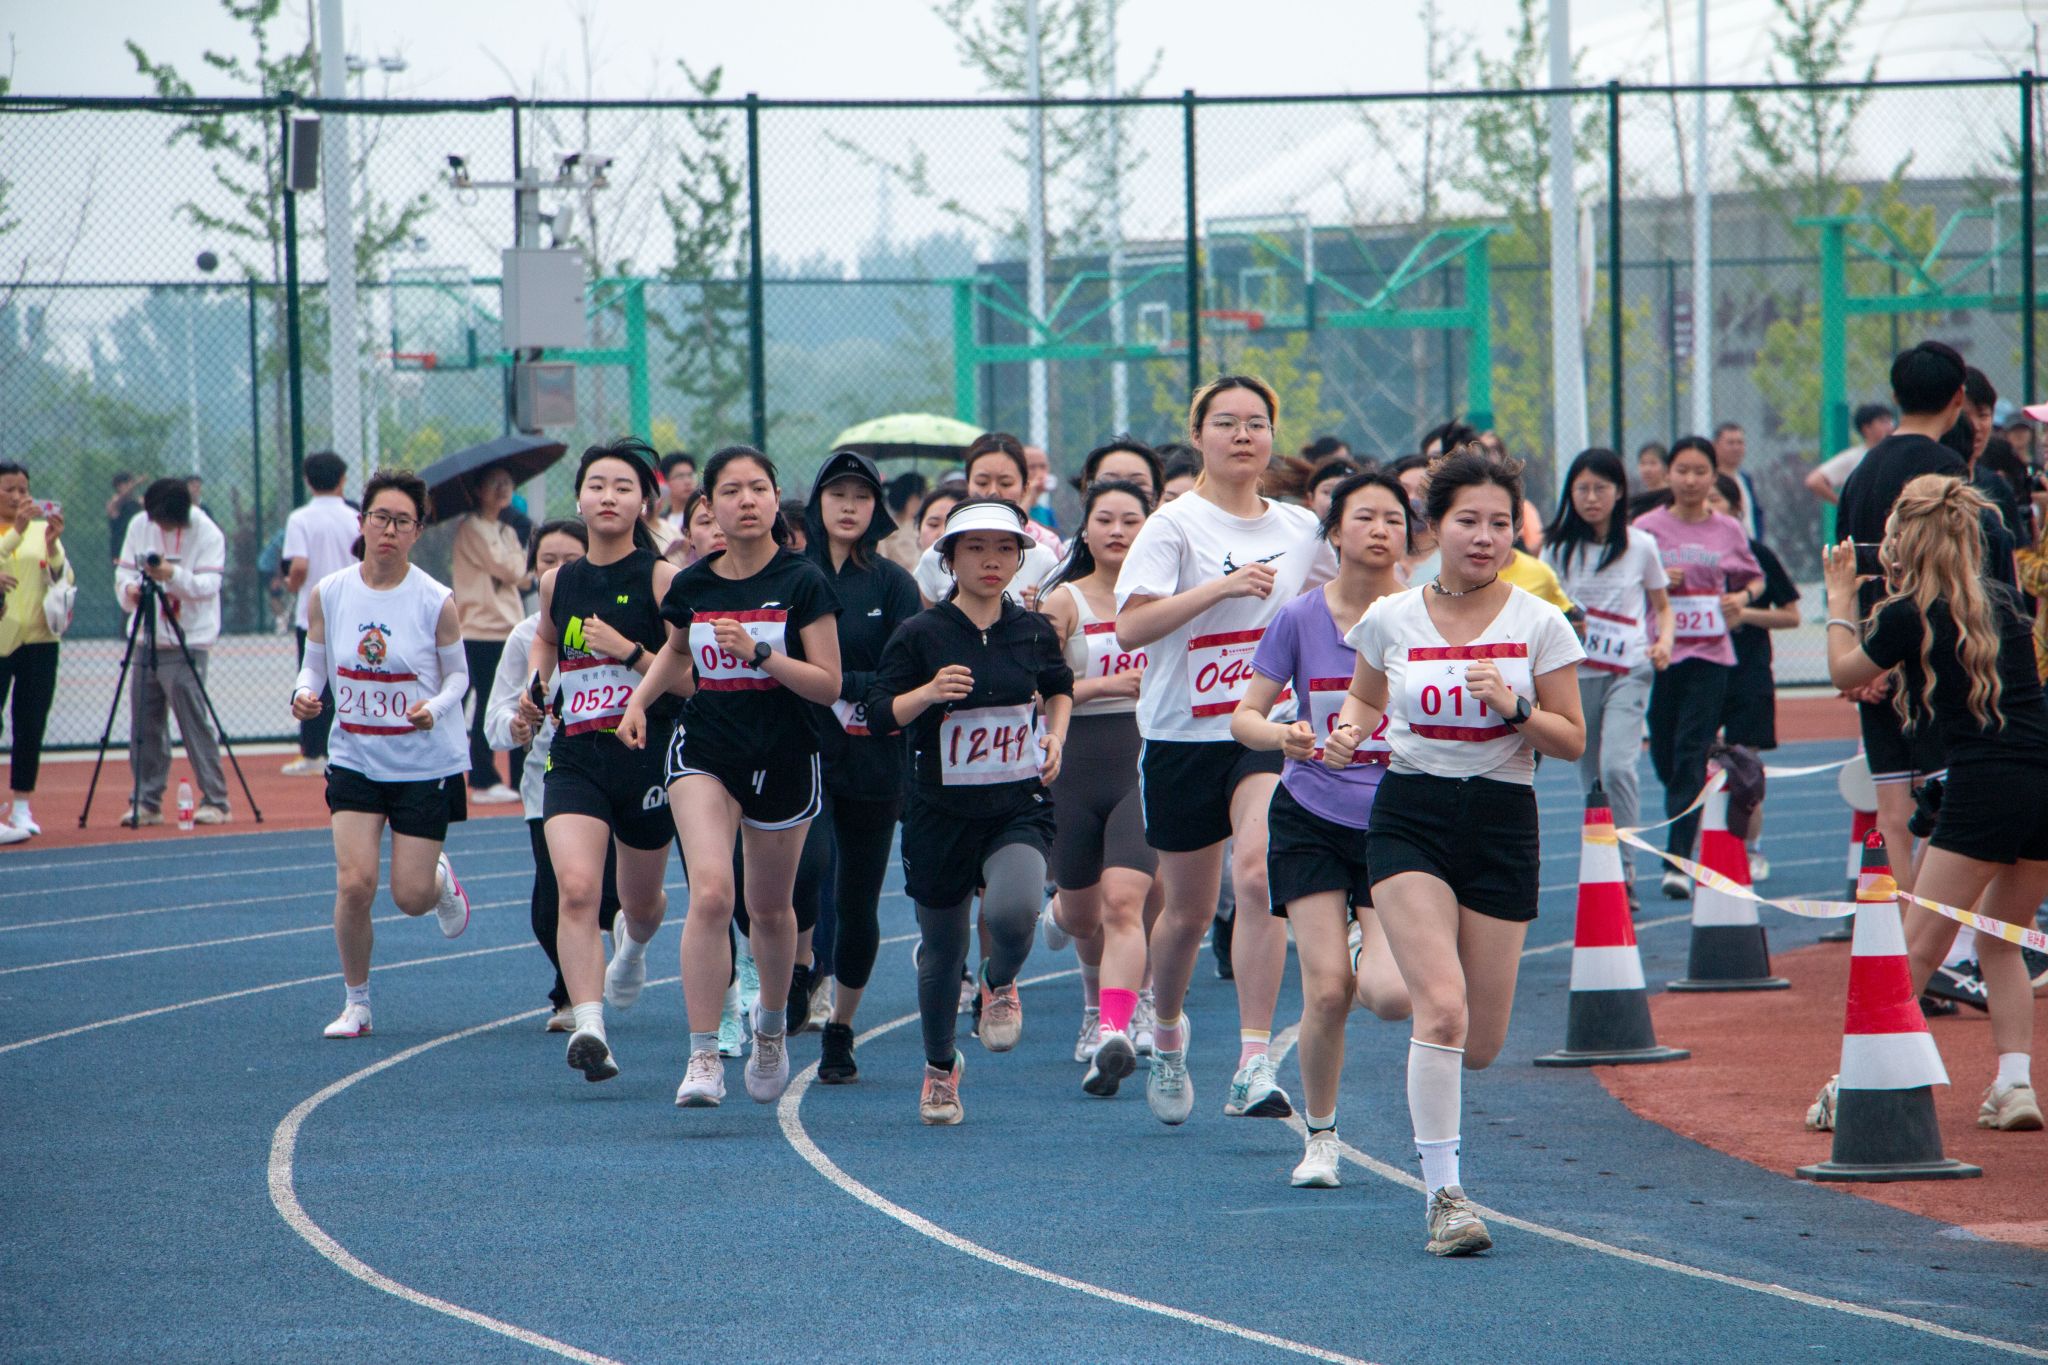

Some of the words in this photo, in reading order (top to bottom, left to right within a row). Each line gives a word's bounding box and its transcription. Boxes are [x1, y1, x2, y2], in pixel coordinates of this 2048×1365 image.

[1675, 611, 1715, 630] 921
[338, 686, 407, 718] 2430
[571, 685, 633, 714] 0522
[949, 723, 1029, 768] 1249
